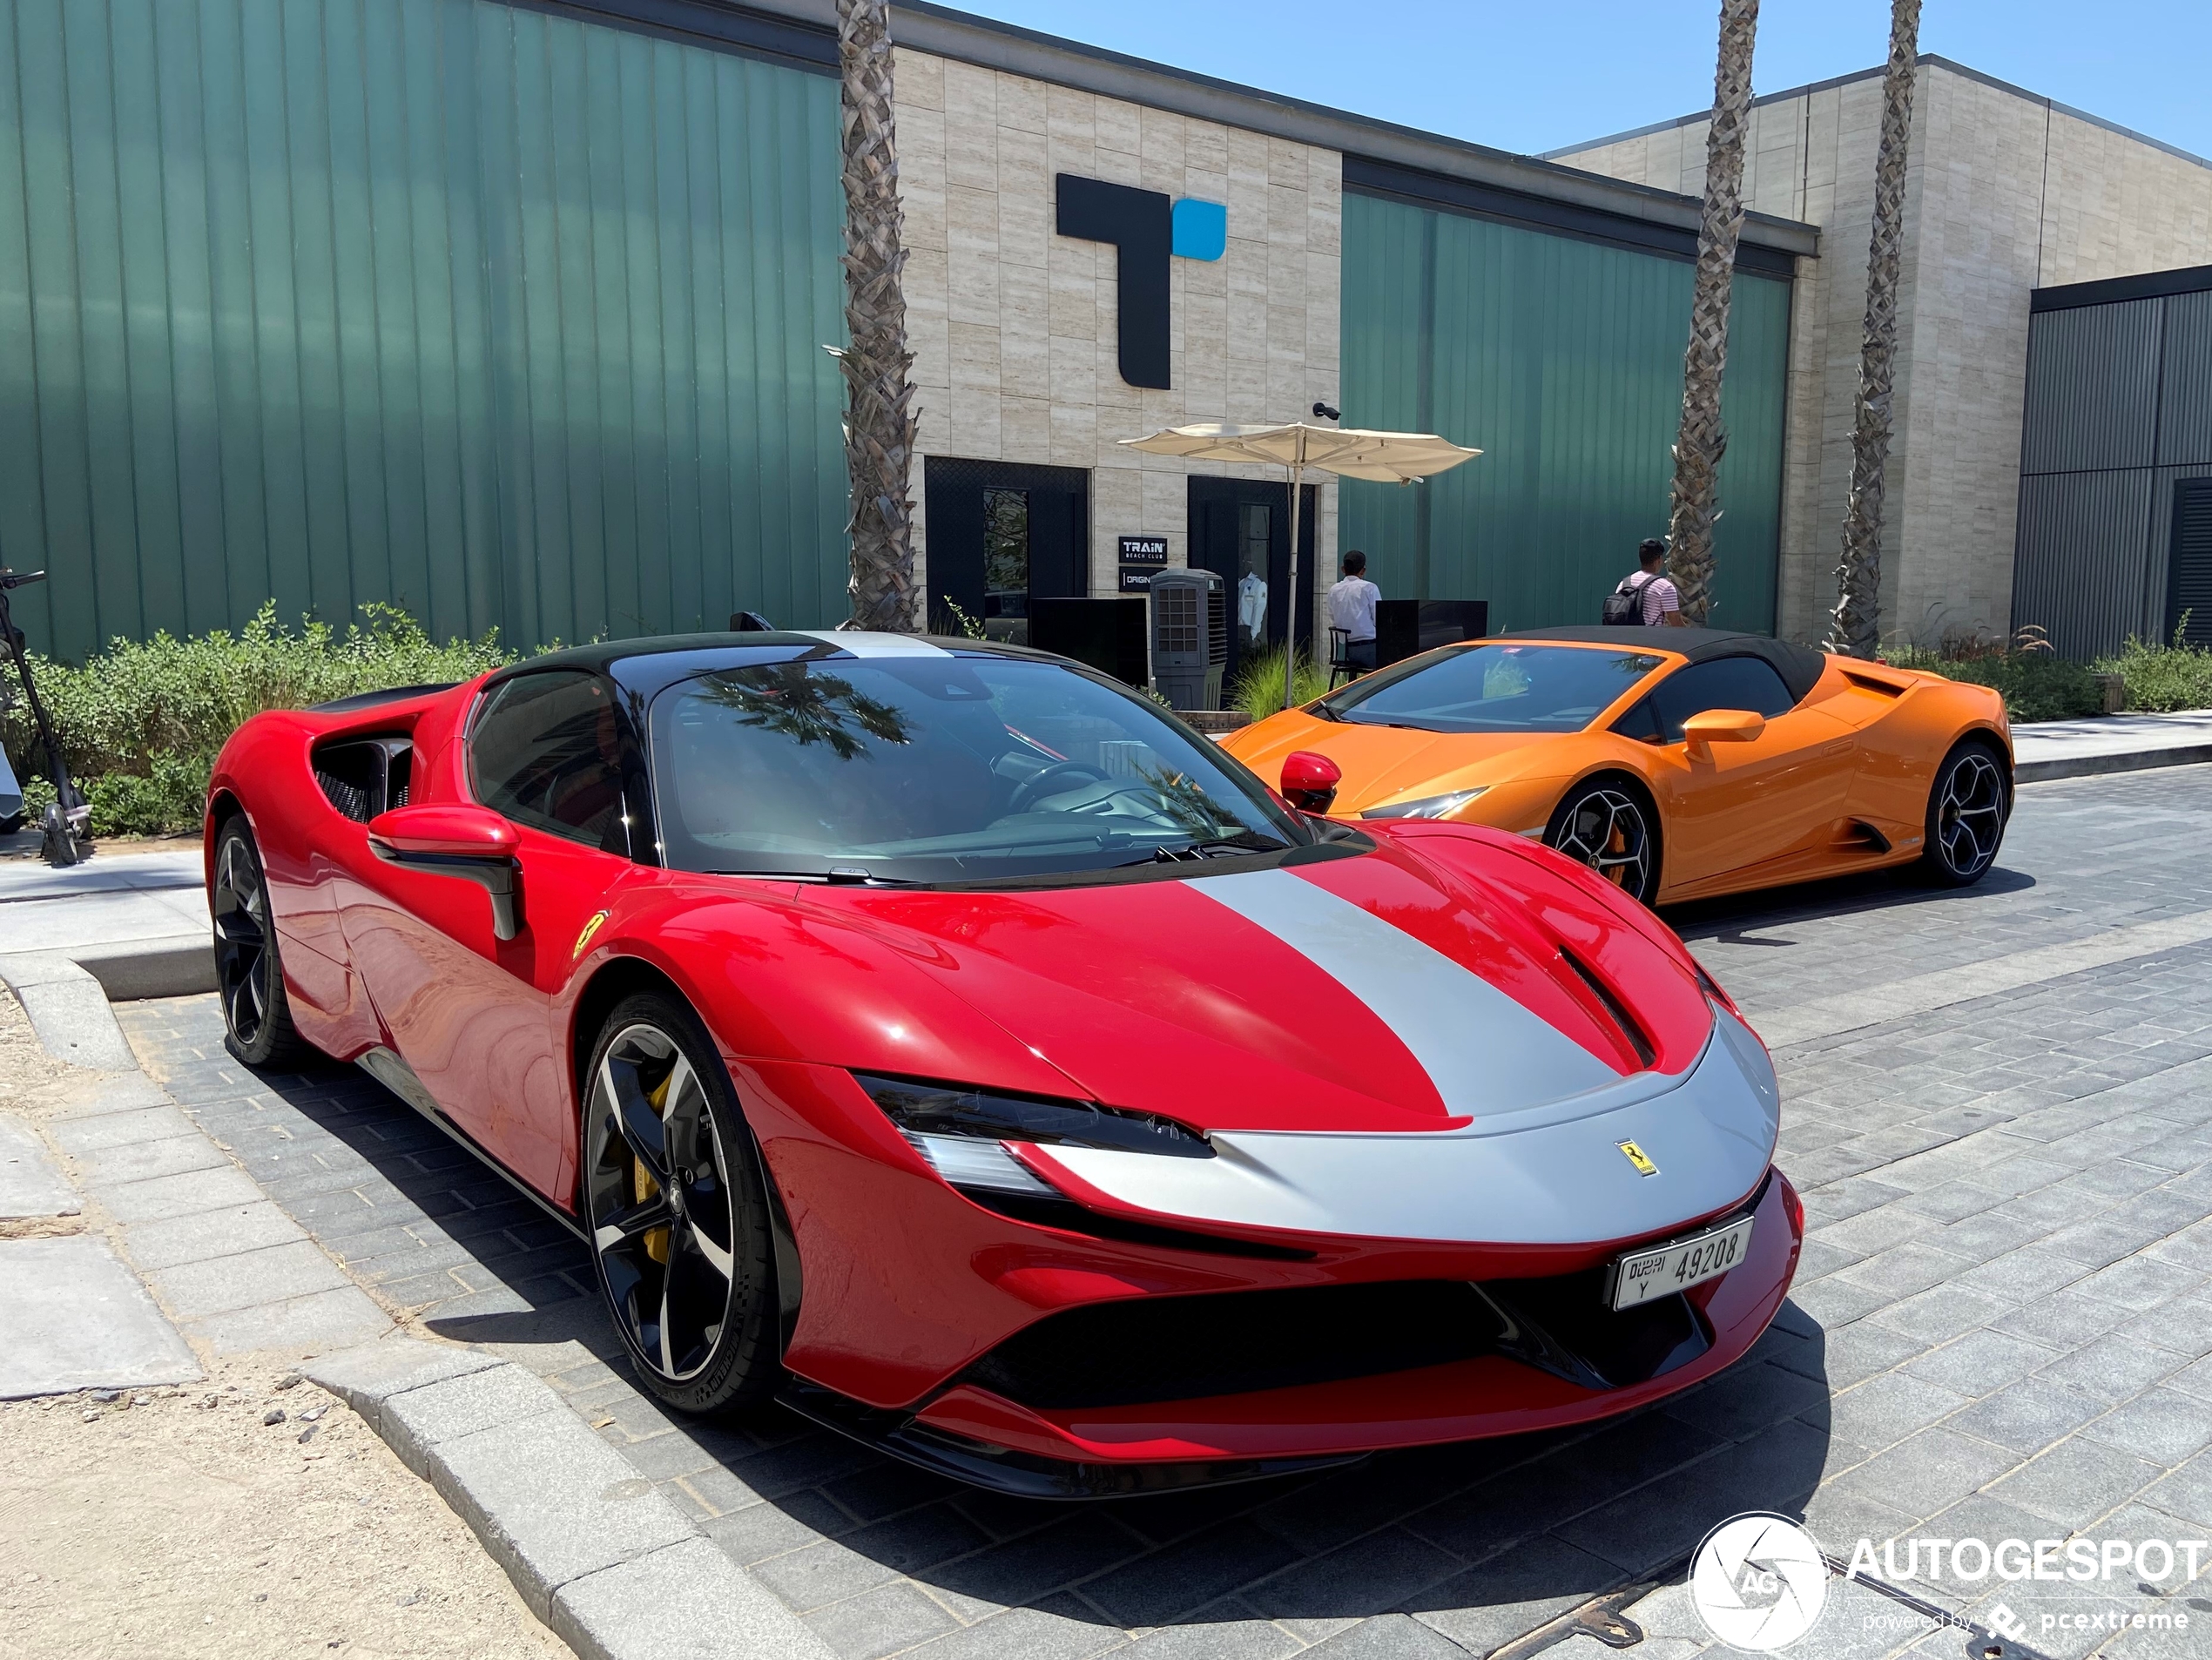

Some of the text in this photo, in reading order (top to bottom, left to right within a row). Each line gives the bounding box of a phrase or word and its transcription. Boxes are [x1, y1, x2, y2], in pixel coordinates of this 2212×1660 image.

[1675, 1232, 1738, 1283] 49208
[1640, 1281, 1649, 1299] Y
[707, 1330, 742, 1393] MICHELIN
